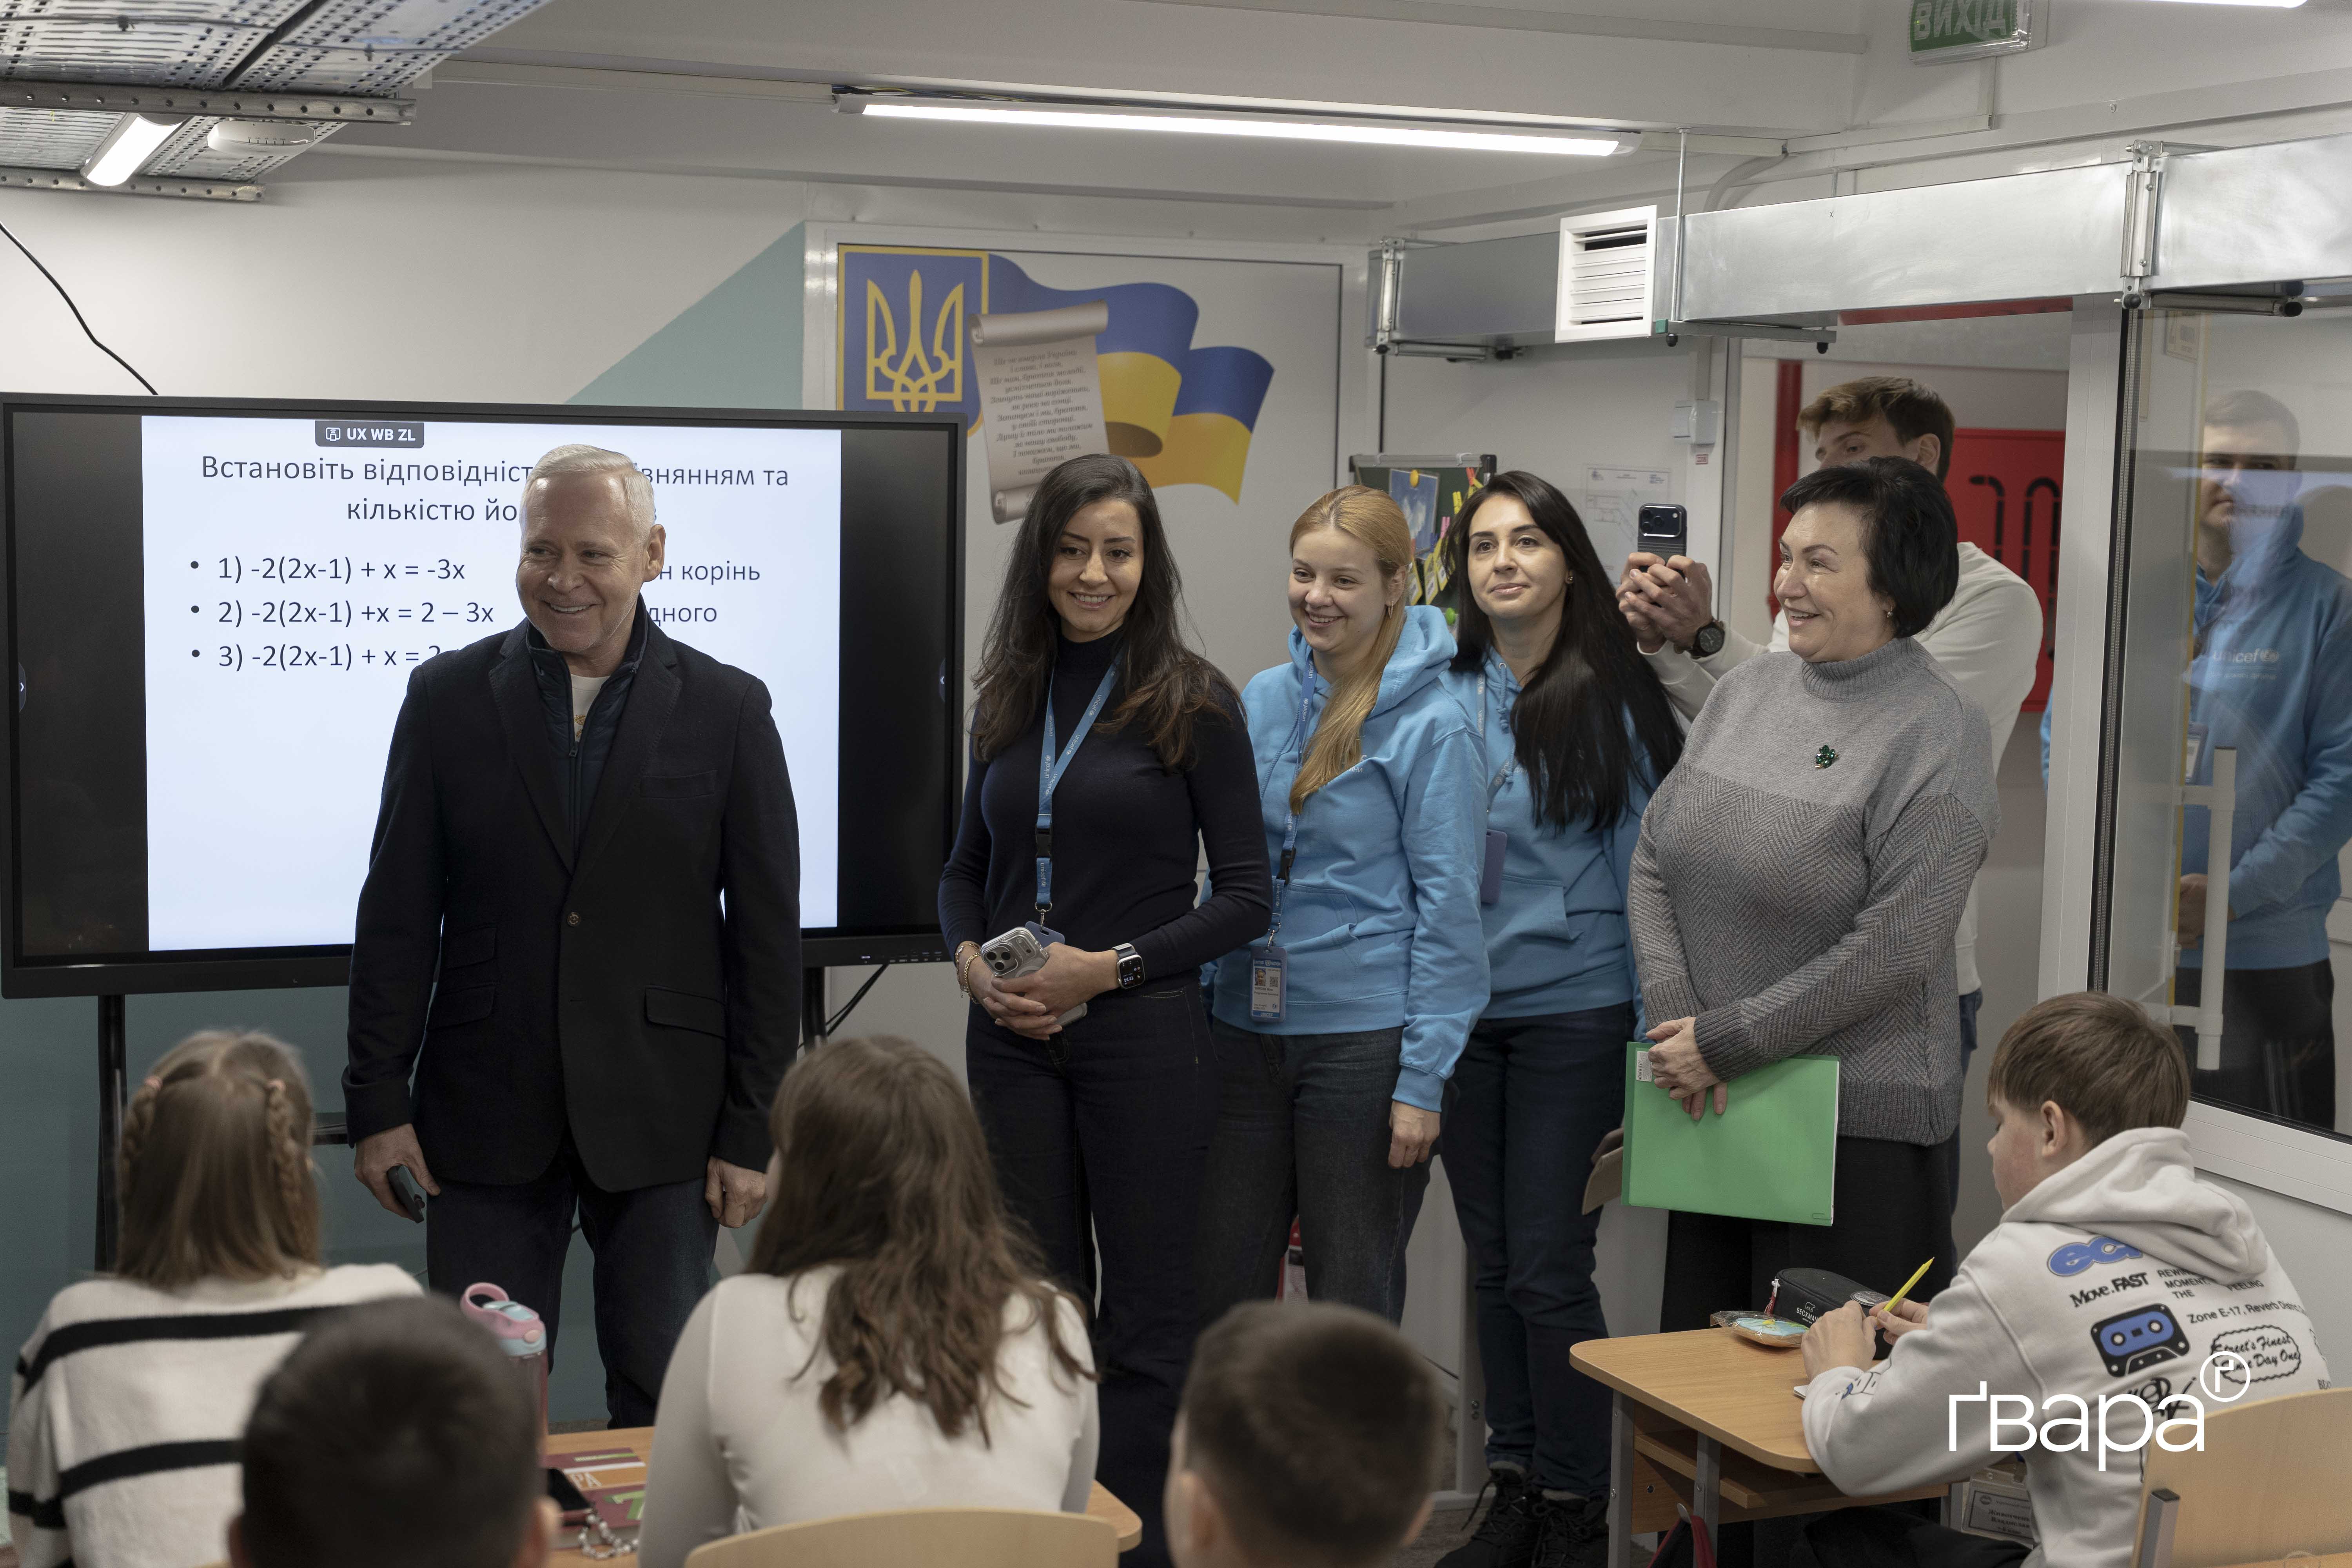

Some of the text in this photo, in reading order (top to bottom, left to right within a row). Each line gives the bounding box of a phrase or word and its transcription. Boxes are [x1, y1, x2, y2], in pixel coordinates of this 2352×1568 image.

[347, 427, 416, 441] UX WB ZL
[203, 456, 788, 487] Встановіть відповідніст внянням та
[348, 497, 517, 521] кількістю йо
[219, 555, 242, 584] 1)
[251, 556, 351, 584] -2(2x-1)
[361, 562, 376, 577] +
[405, 566, 419, 575] =
[427, 559, 465, 579] -3x
[682, 560, 760, 585] корінь
[218, 600, 242, 628] 2)
[251, 600, 352, 628] -2(2x-1)
[398, 609, 412, 618] =
[421, 602, 435, 622] 2
[466, 602, 494, 622] 3x
[649, 606, 717, 626] дного
[219, 644, 243, 672] 3)
[252, 643, 352, 671] -2(2x-1)
[361, 649, 376, 664] +
[405, 652, 419, 661] =
[1092, 694, 1102, 711] unicef
[1069, 734, 1080, 751] unicef
[1047, 773, 1058, 791] unicef
[2172, 1278, 2265, 1299] THE FEELING
[2186, 1311, 2218, 1324] Zone
[2245, 1300, 2279, 1314] Reverb
[2253, 1353, 2278, 1367] Day
